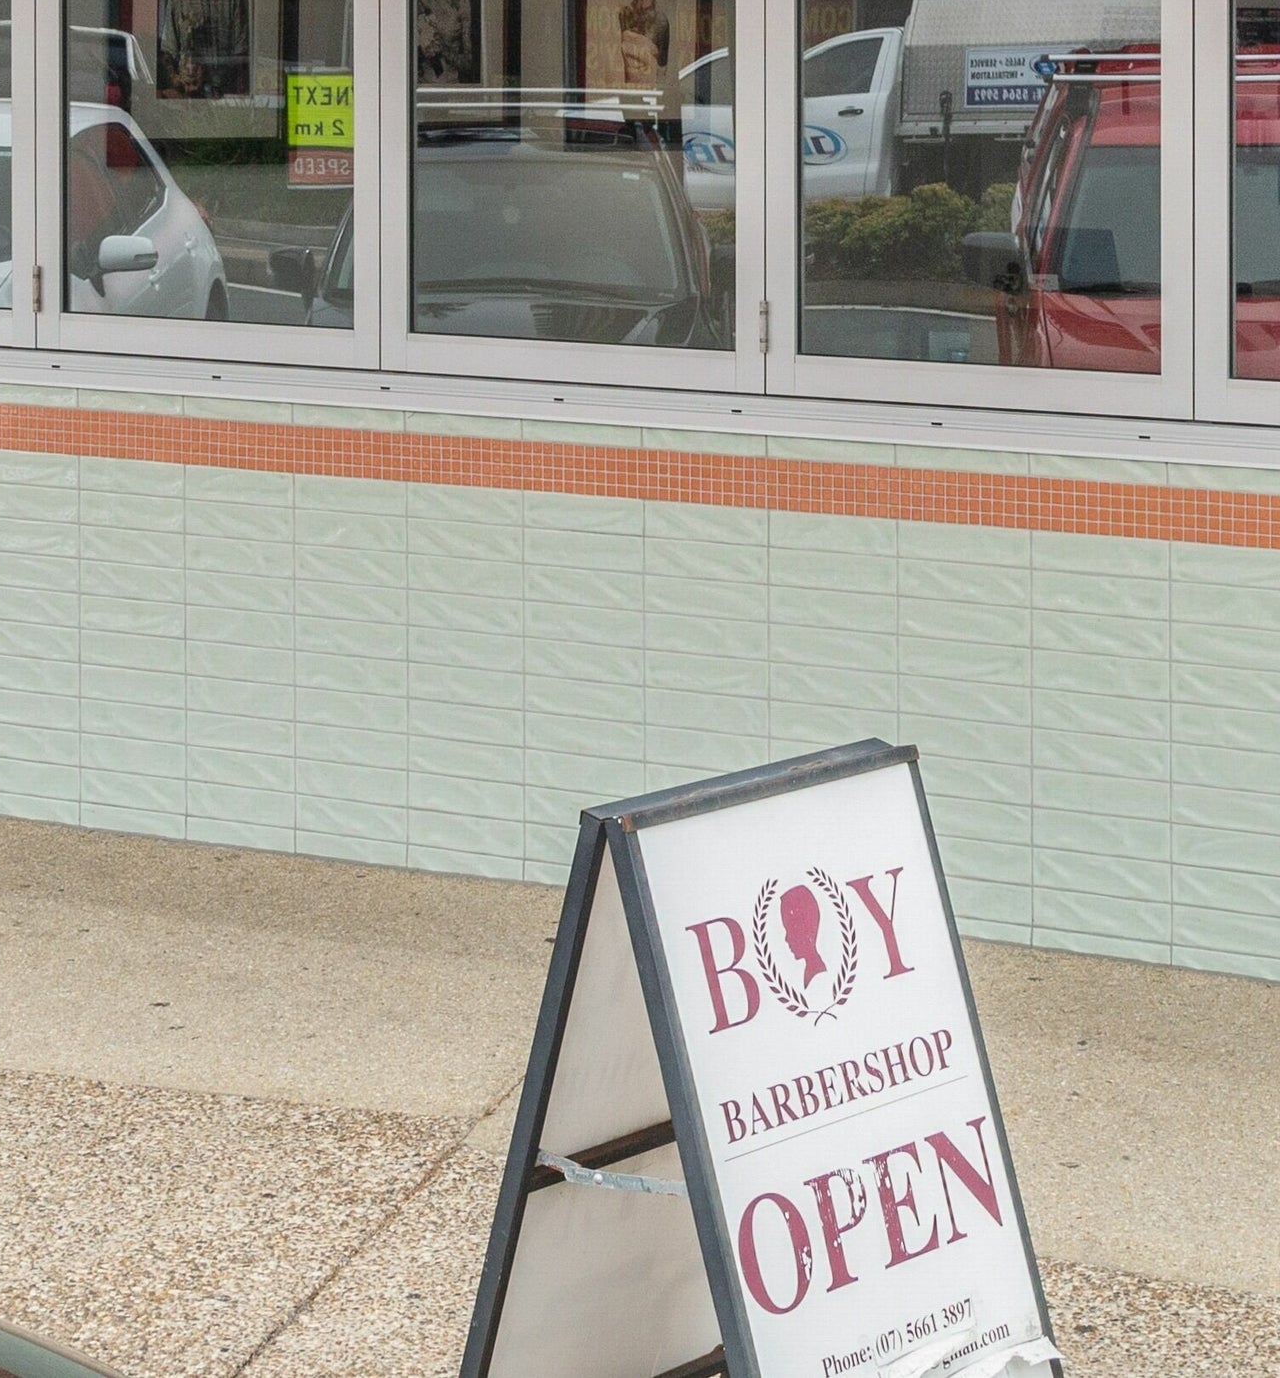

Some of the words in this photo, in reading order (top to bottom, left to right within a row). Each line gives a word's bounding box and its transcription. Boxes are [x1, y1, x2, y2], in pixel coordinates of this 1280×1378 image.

[718, 1028, 954, 1145] BARBERSHOP
[737, 1115, 1005, 1316] OPEN
[821, 1345, 874, 1378] Phone:
[875, 1329, 904, 1360] (07)
[906, 1312, 939, 1344] 5661
[941, 1298, 972, 1329] 3897
